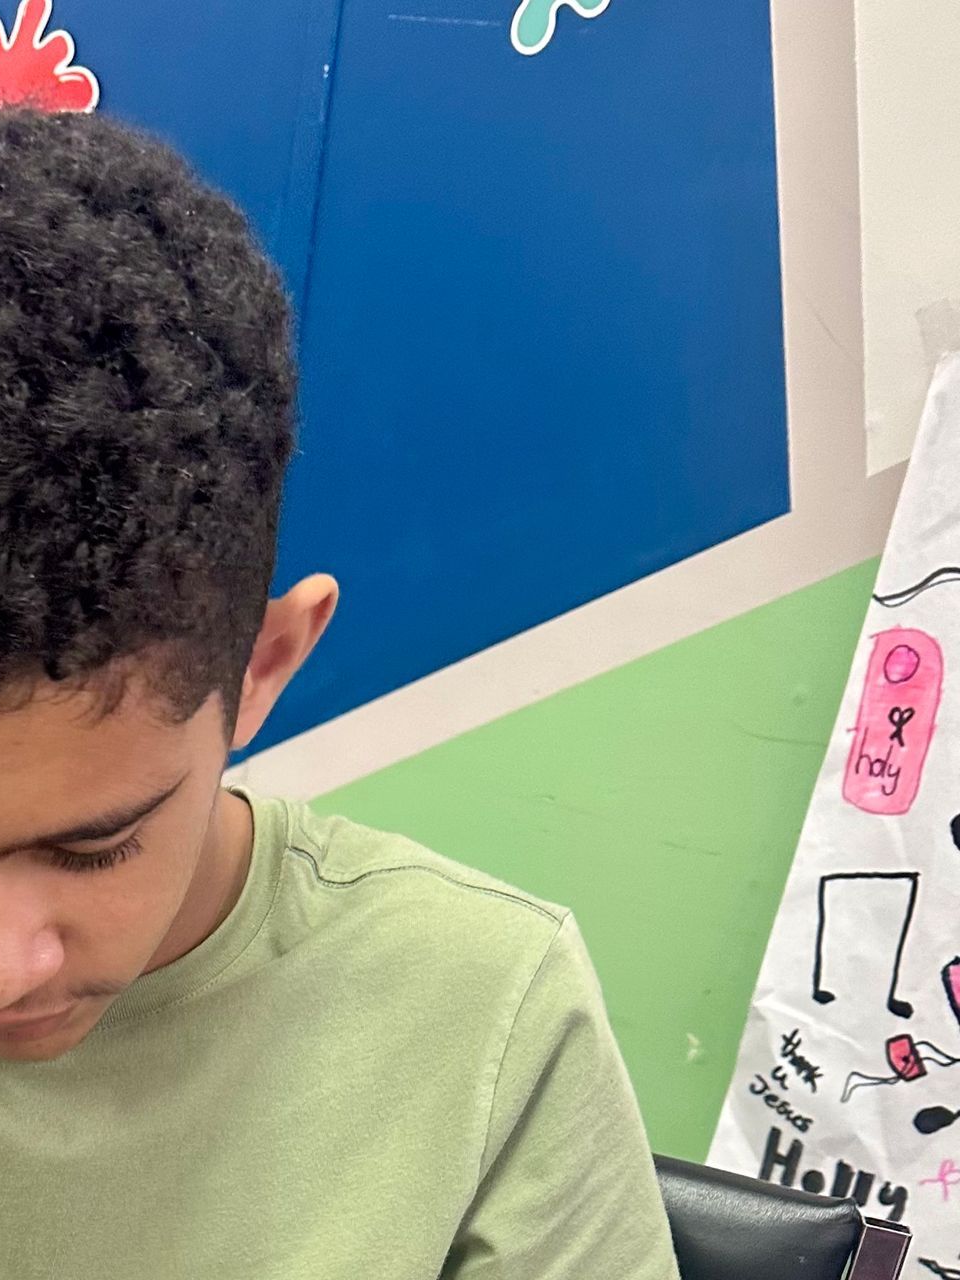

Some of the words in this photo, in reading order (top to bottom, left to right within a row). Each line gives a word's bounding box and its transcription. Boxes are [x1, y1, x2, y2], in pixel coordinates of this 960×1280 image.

[854, 727, 902, 797] holy
[749, 1073, 815, 1133] Jesus
[758, 1125, 909, 1223] Holly
